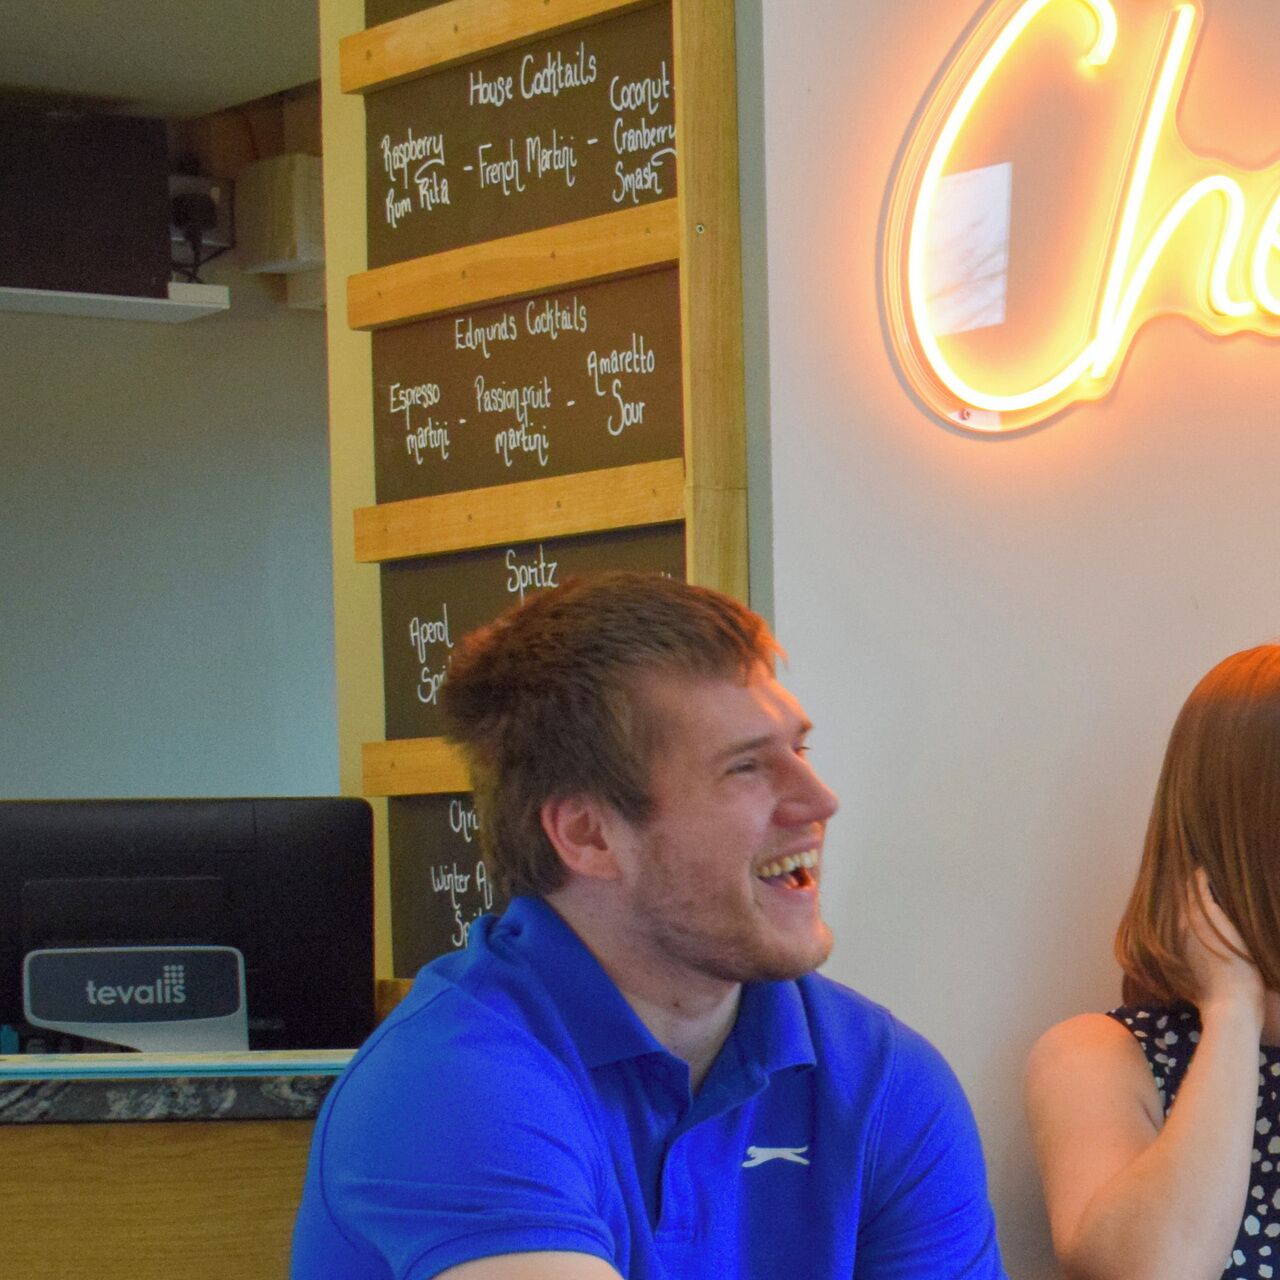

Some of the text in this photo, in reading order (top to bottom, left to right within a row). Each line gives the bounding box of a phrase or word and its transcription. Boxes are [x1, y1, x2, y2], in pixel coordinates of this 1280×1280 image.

[470, 41, 597, 107] House Cocktails
[610, 61, 671, 115] Coconut
[381, 128, 445, 189] Raspberry
[478, 128, 577, 196] French Martini
[612, 161, 663, 203] Smash
[385, 171, 450, 228] Rum Rita
[455, 296, 587, 359] Edmunds Cocktails
[587, 332, 655, 396] Amaretto
[390, 383, 440, 430] Espresso
[608, 379, 645, 436] Sour
[406, 417, 450, 465] martini
[495, 423, 549, 467] martini
[506, 544, 559, 606] Spritz
[409, 603, 454, 664] Aperol
[417, 656, 452, 705] Spri
[431, 863, 470, 909] Winter
[86, 976, 187, 1006] tevalis
